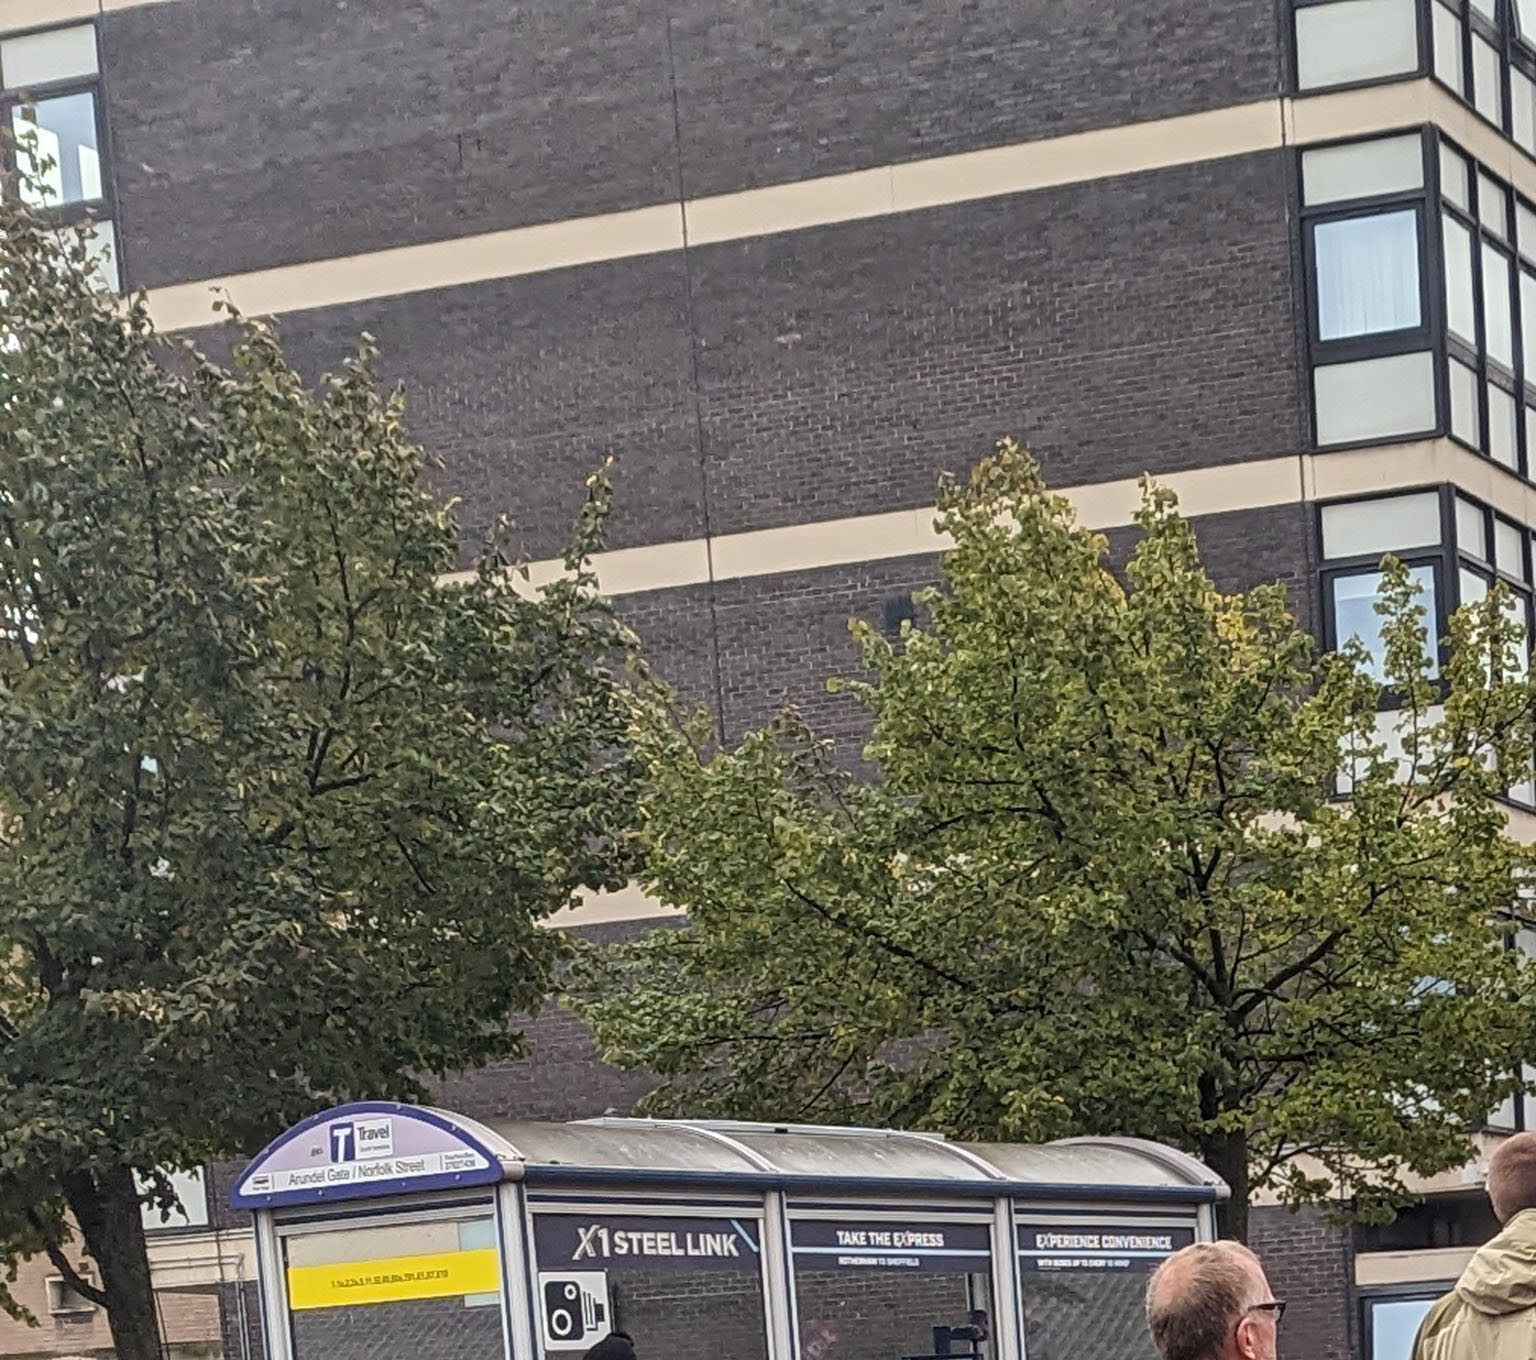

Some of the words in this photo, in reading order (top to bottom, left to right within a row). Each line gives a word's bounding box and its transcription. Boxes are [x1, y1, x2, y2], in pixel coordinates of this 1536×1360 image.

[357, 1125, 390, 1141] Travel
[288, 1170, 326, 1186] Arundel
[327, 1168, 350, 1181] Gate
[358, 1161, 393, 1178] Norfolk
[395, 1159, 425, 1174] Street
[572, 1224, 610, 1260] X1
[614, 1231, 685, 1256] STEEL
[686, 1232, 739, 1257] LINK
[836, 1230, 867, 1246] TAKE
[868, 1231, 891, 1246] THE
[893, 1230, 944, 1247] EXPRESS
[1036, 1232, 1100, 1249] EXPERIENCE
[1101, 1235, 1172, 1249] CONVENIENCE
